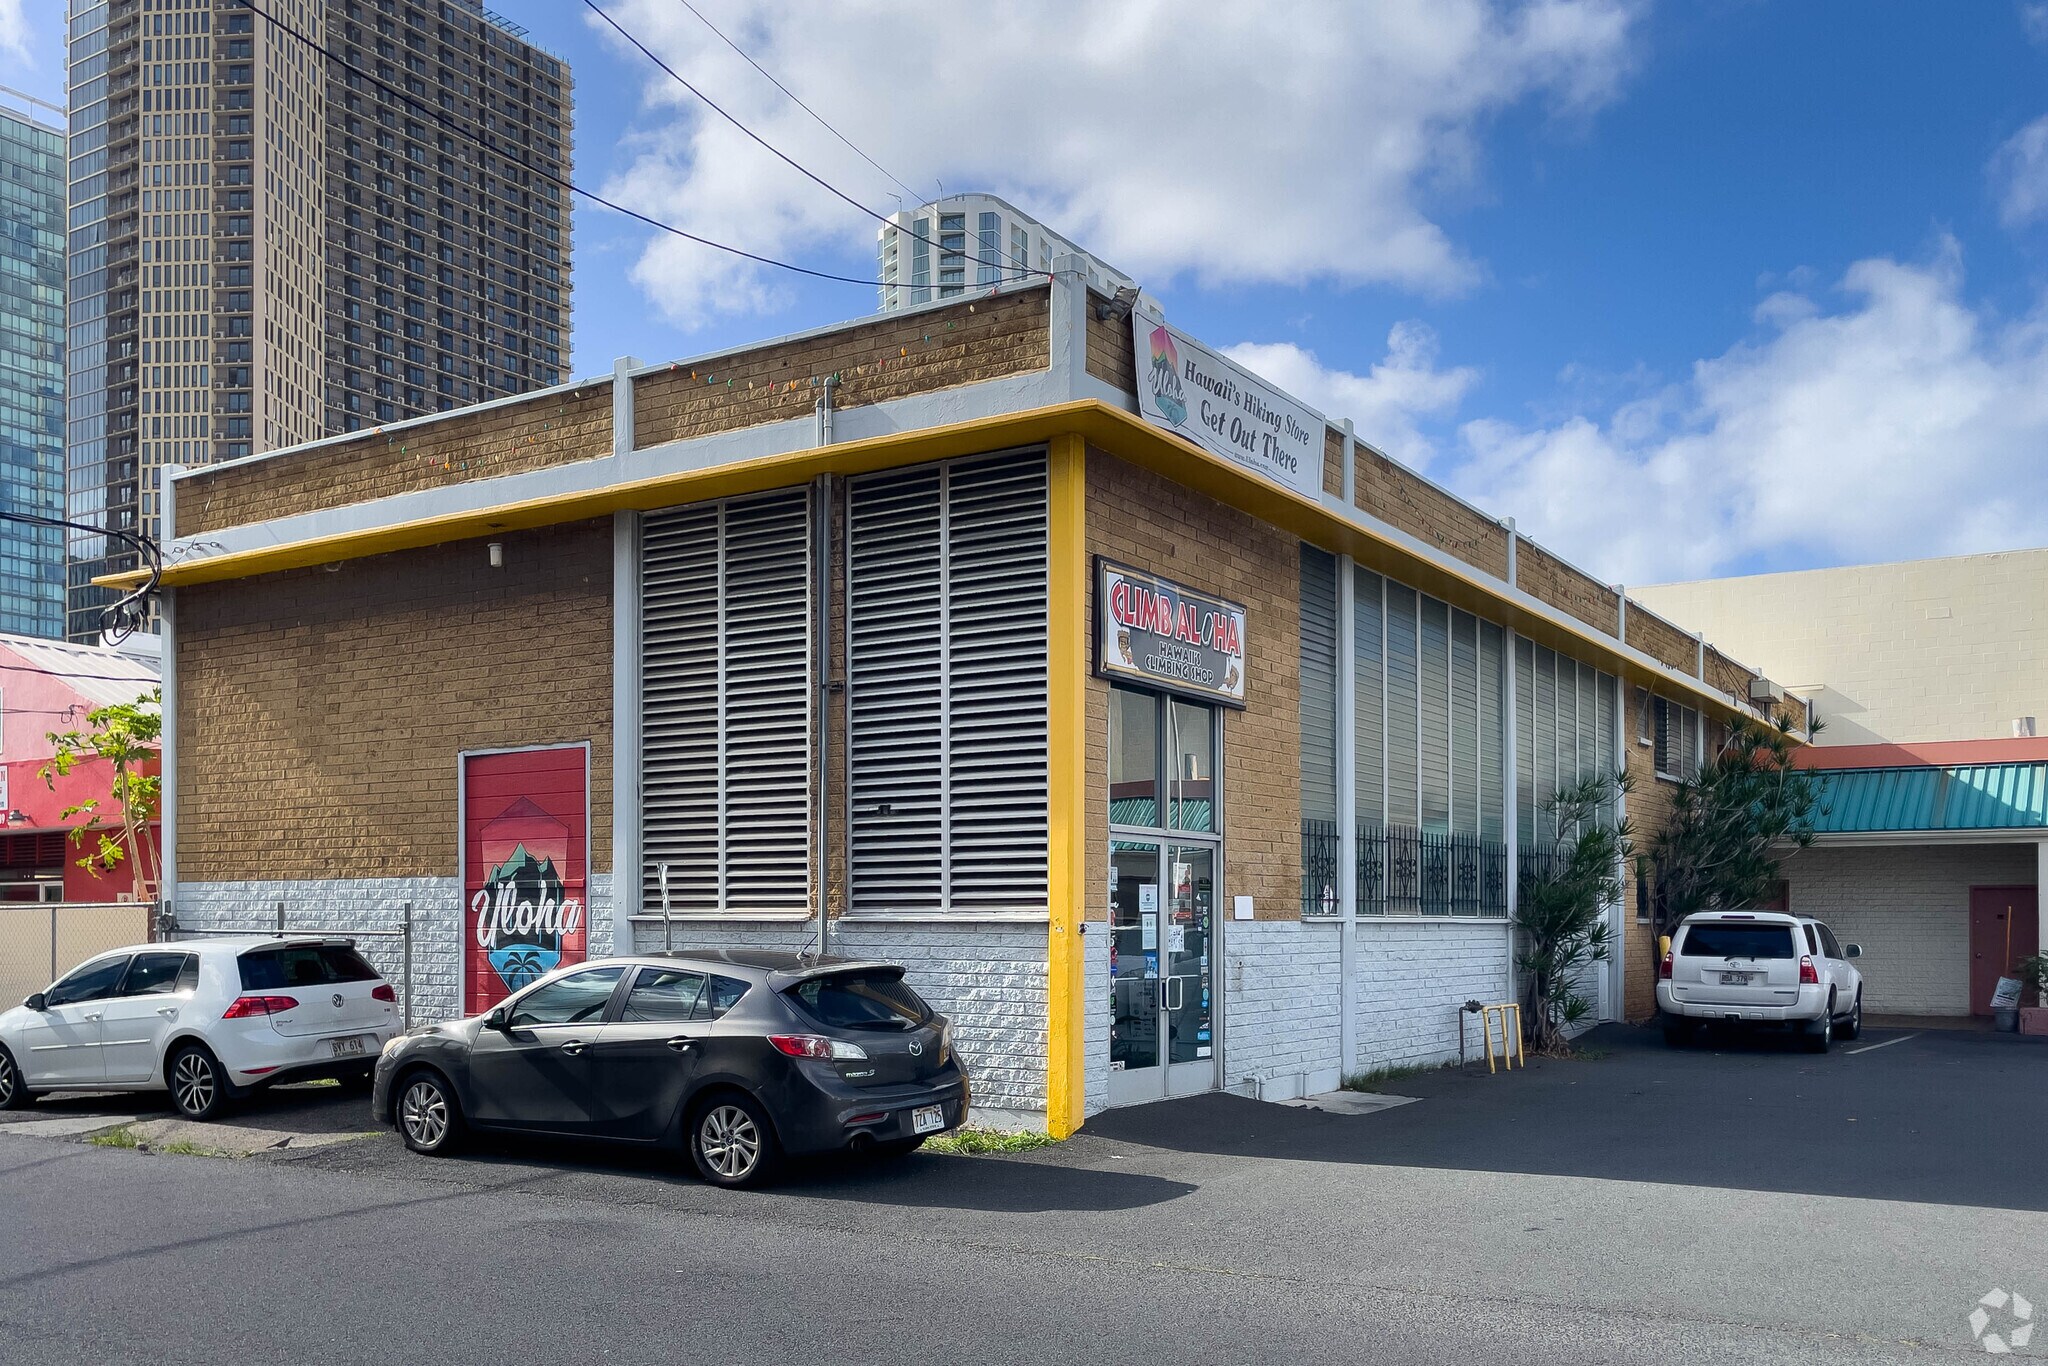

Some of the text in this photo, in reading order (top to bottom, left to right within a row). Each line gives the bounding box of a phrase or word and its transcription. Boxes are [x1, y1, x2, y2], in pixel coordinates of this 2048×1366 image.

[1184, 358, 1310, 447] Hawaii's Hiking Store
[1200, 399, 1298, 475] Get Out There
[1110, 580, 1242, 658] CLIMB ALOHA
[1158, 640, 1202, 667] HAWAII'S
[1144, 653, 1214, 685] CLIMBING SHOP
